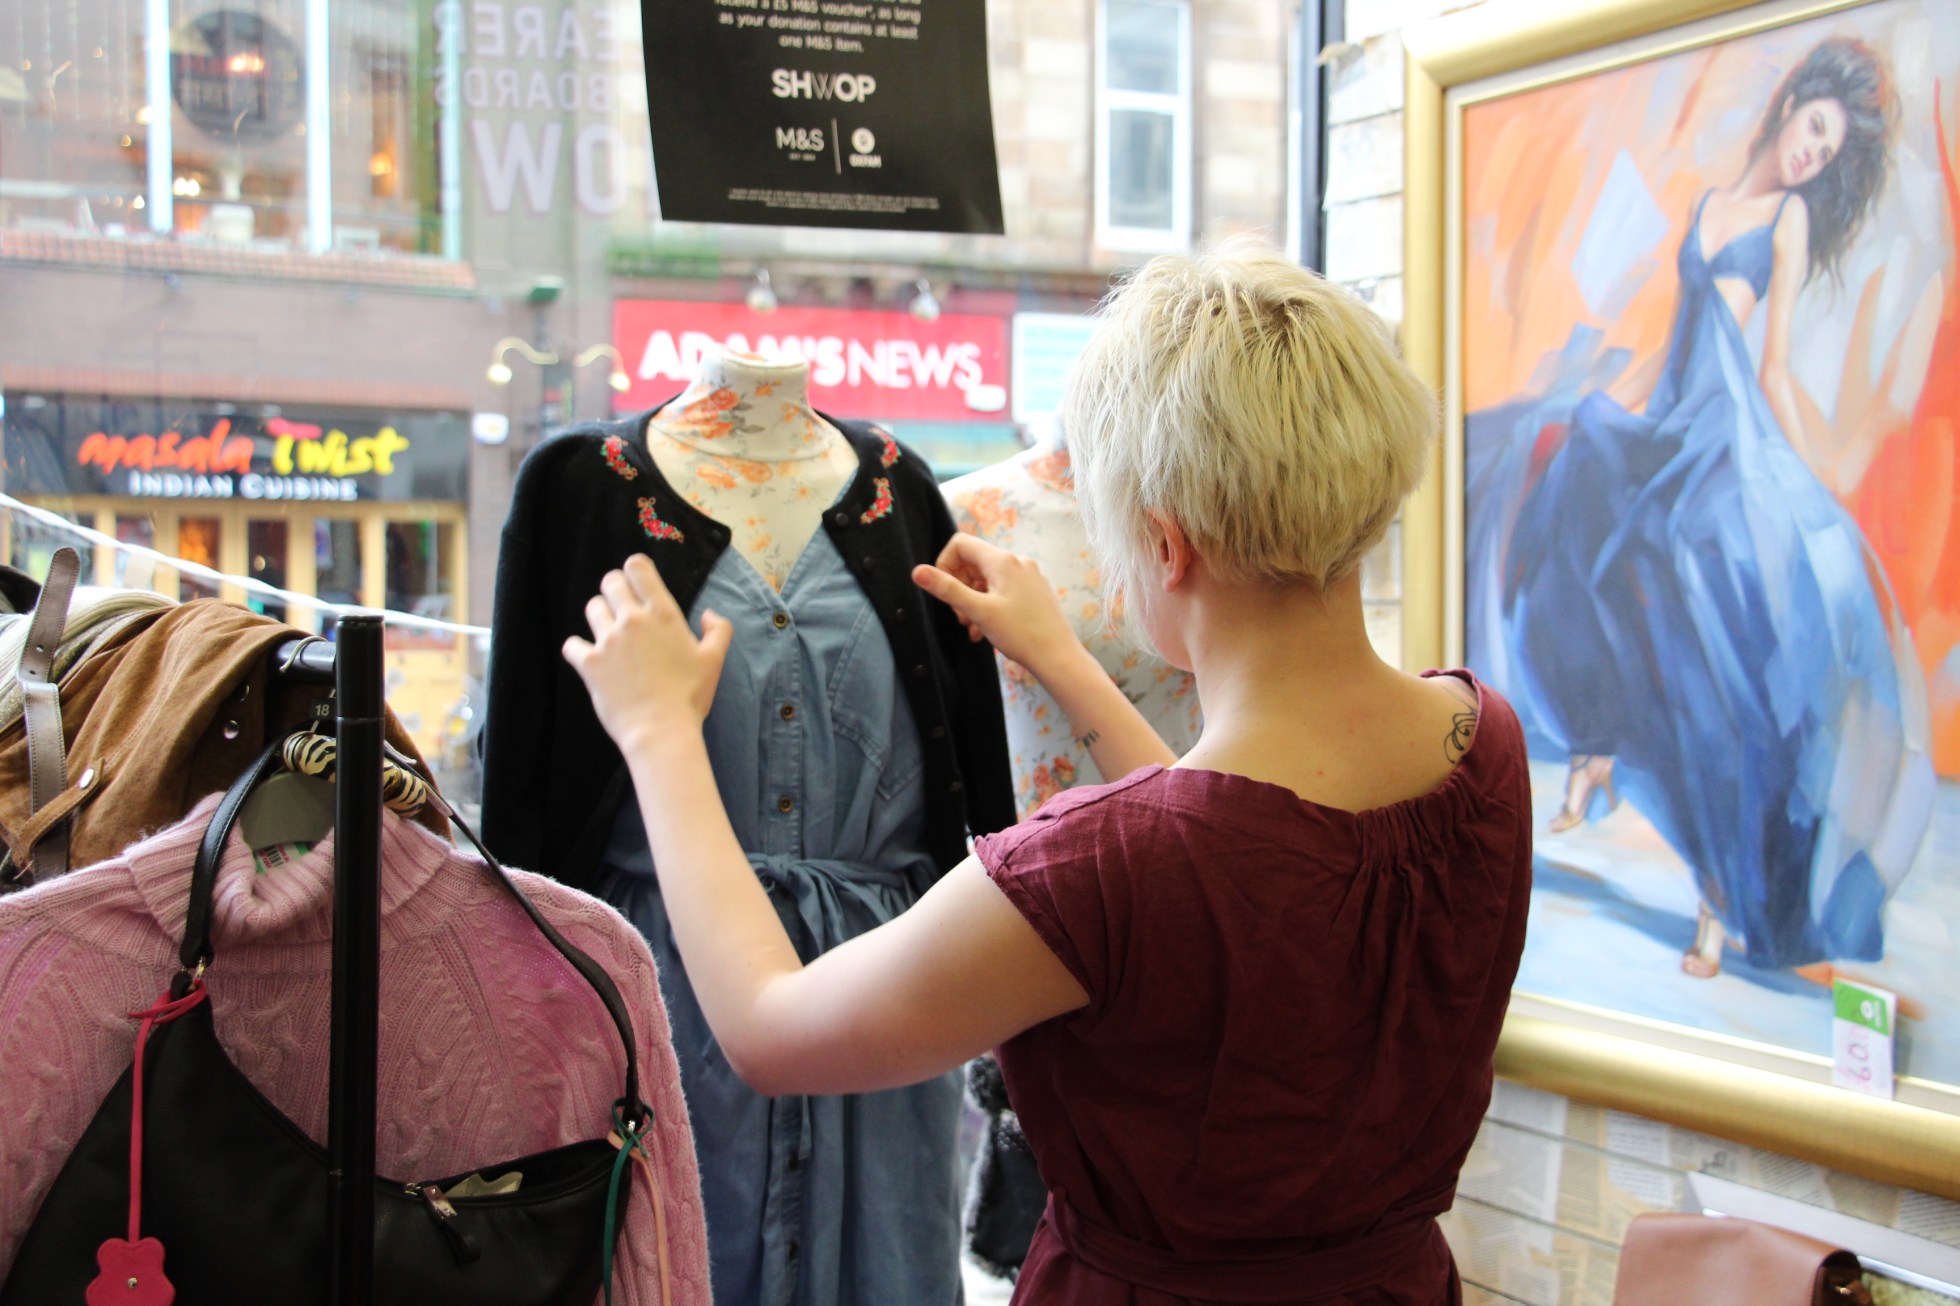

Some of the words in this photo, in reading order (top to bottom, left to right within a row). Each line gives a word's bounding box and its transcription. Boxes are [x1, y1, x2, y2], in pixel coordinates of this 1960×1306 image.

[719, 12, 734, 25] as
[736, 13, 765, 28] your
[767, 13, 821, 31] donation
[823, 20, 873, 36] contains
[874, 23, 888, 37] at
[890, 23, 918, 40] least
[877, 6, 893, 20] as
[893, 6, 921, 25] long
[778, 34, 803, 48] one
[805, 35, 832, 51] M&S
[771, 68, 876, 102] SHWOP
[775, 126, 824, 151] M&S
[848, 338, 983, 390] NEWS
[128, 469, 234, 498] INDIAN
[239, 472, 358, 500] CUISINE
[314, 703, 330, 717] 18
